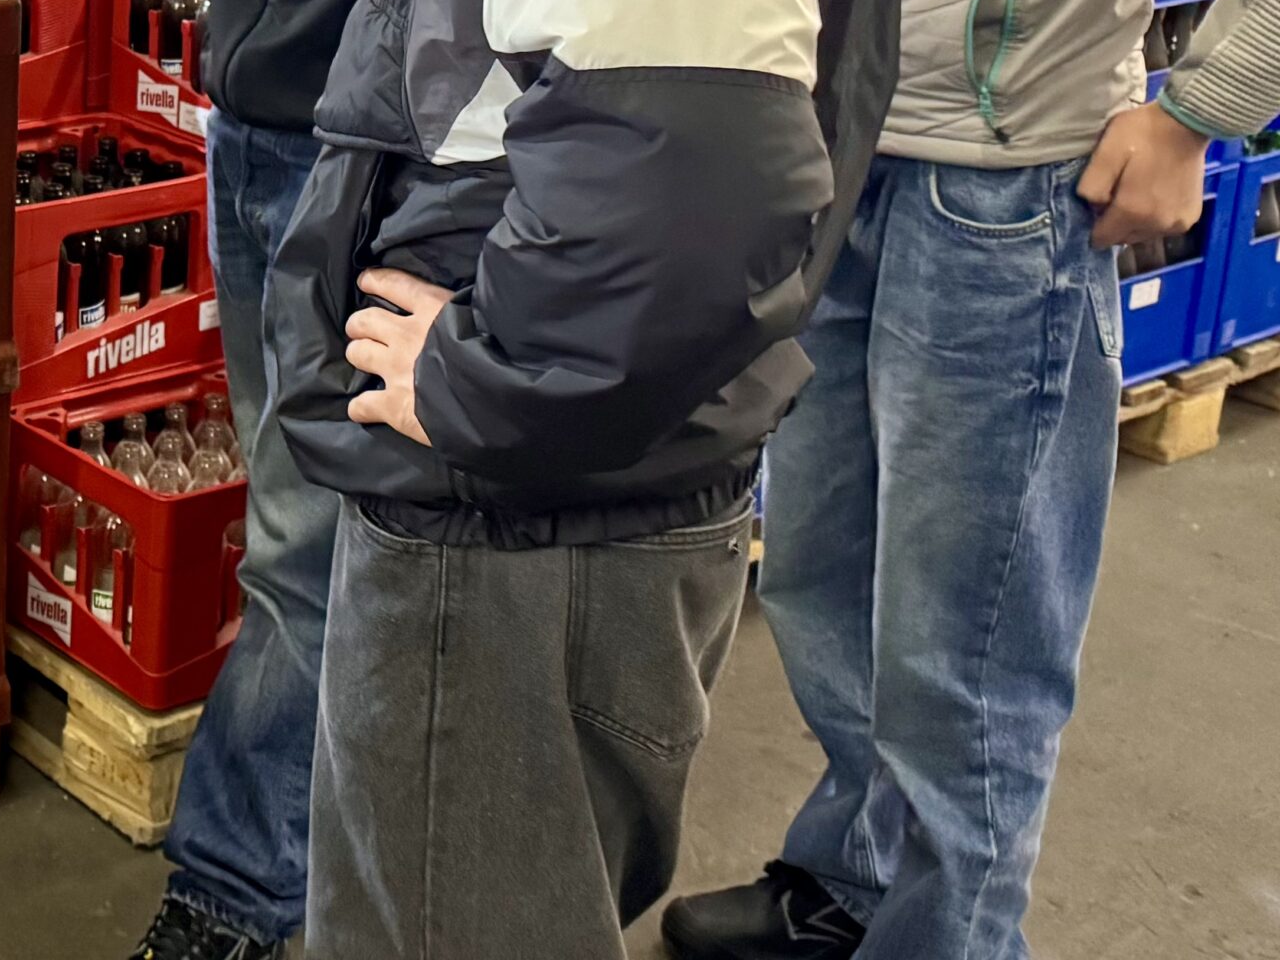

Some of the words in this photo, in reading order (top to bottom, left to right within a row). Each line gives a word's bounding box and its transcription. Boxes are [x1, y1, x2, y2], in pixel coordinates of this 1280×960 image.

[140, 87, 175, 109] rivella
[87, 320, 166, 379] rivella
[30, 595, 68, 625] rivella
